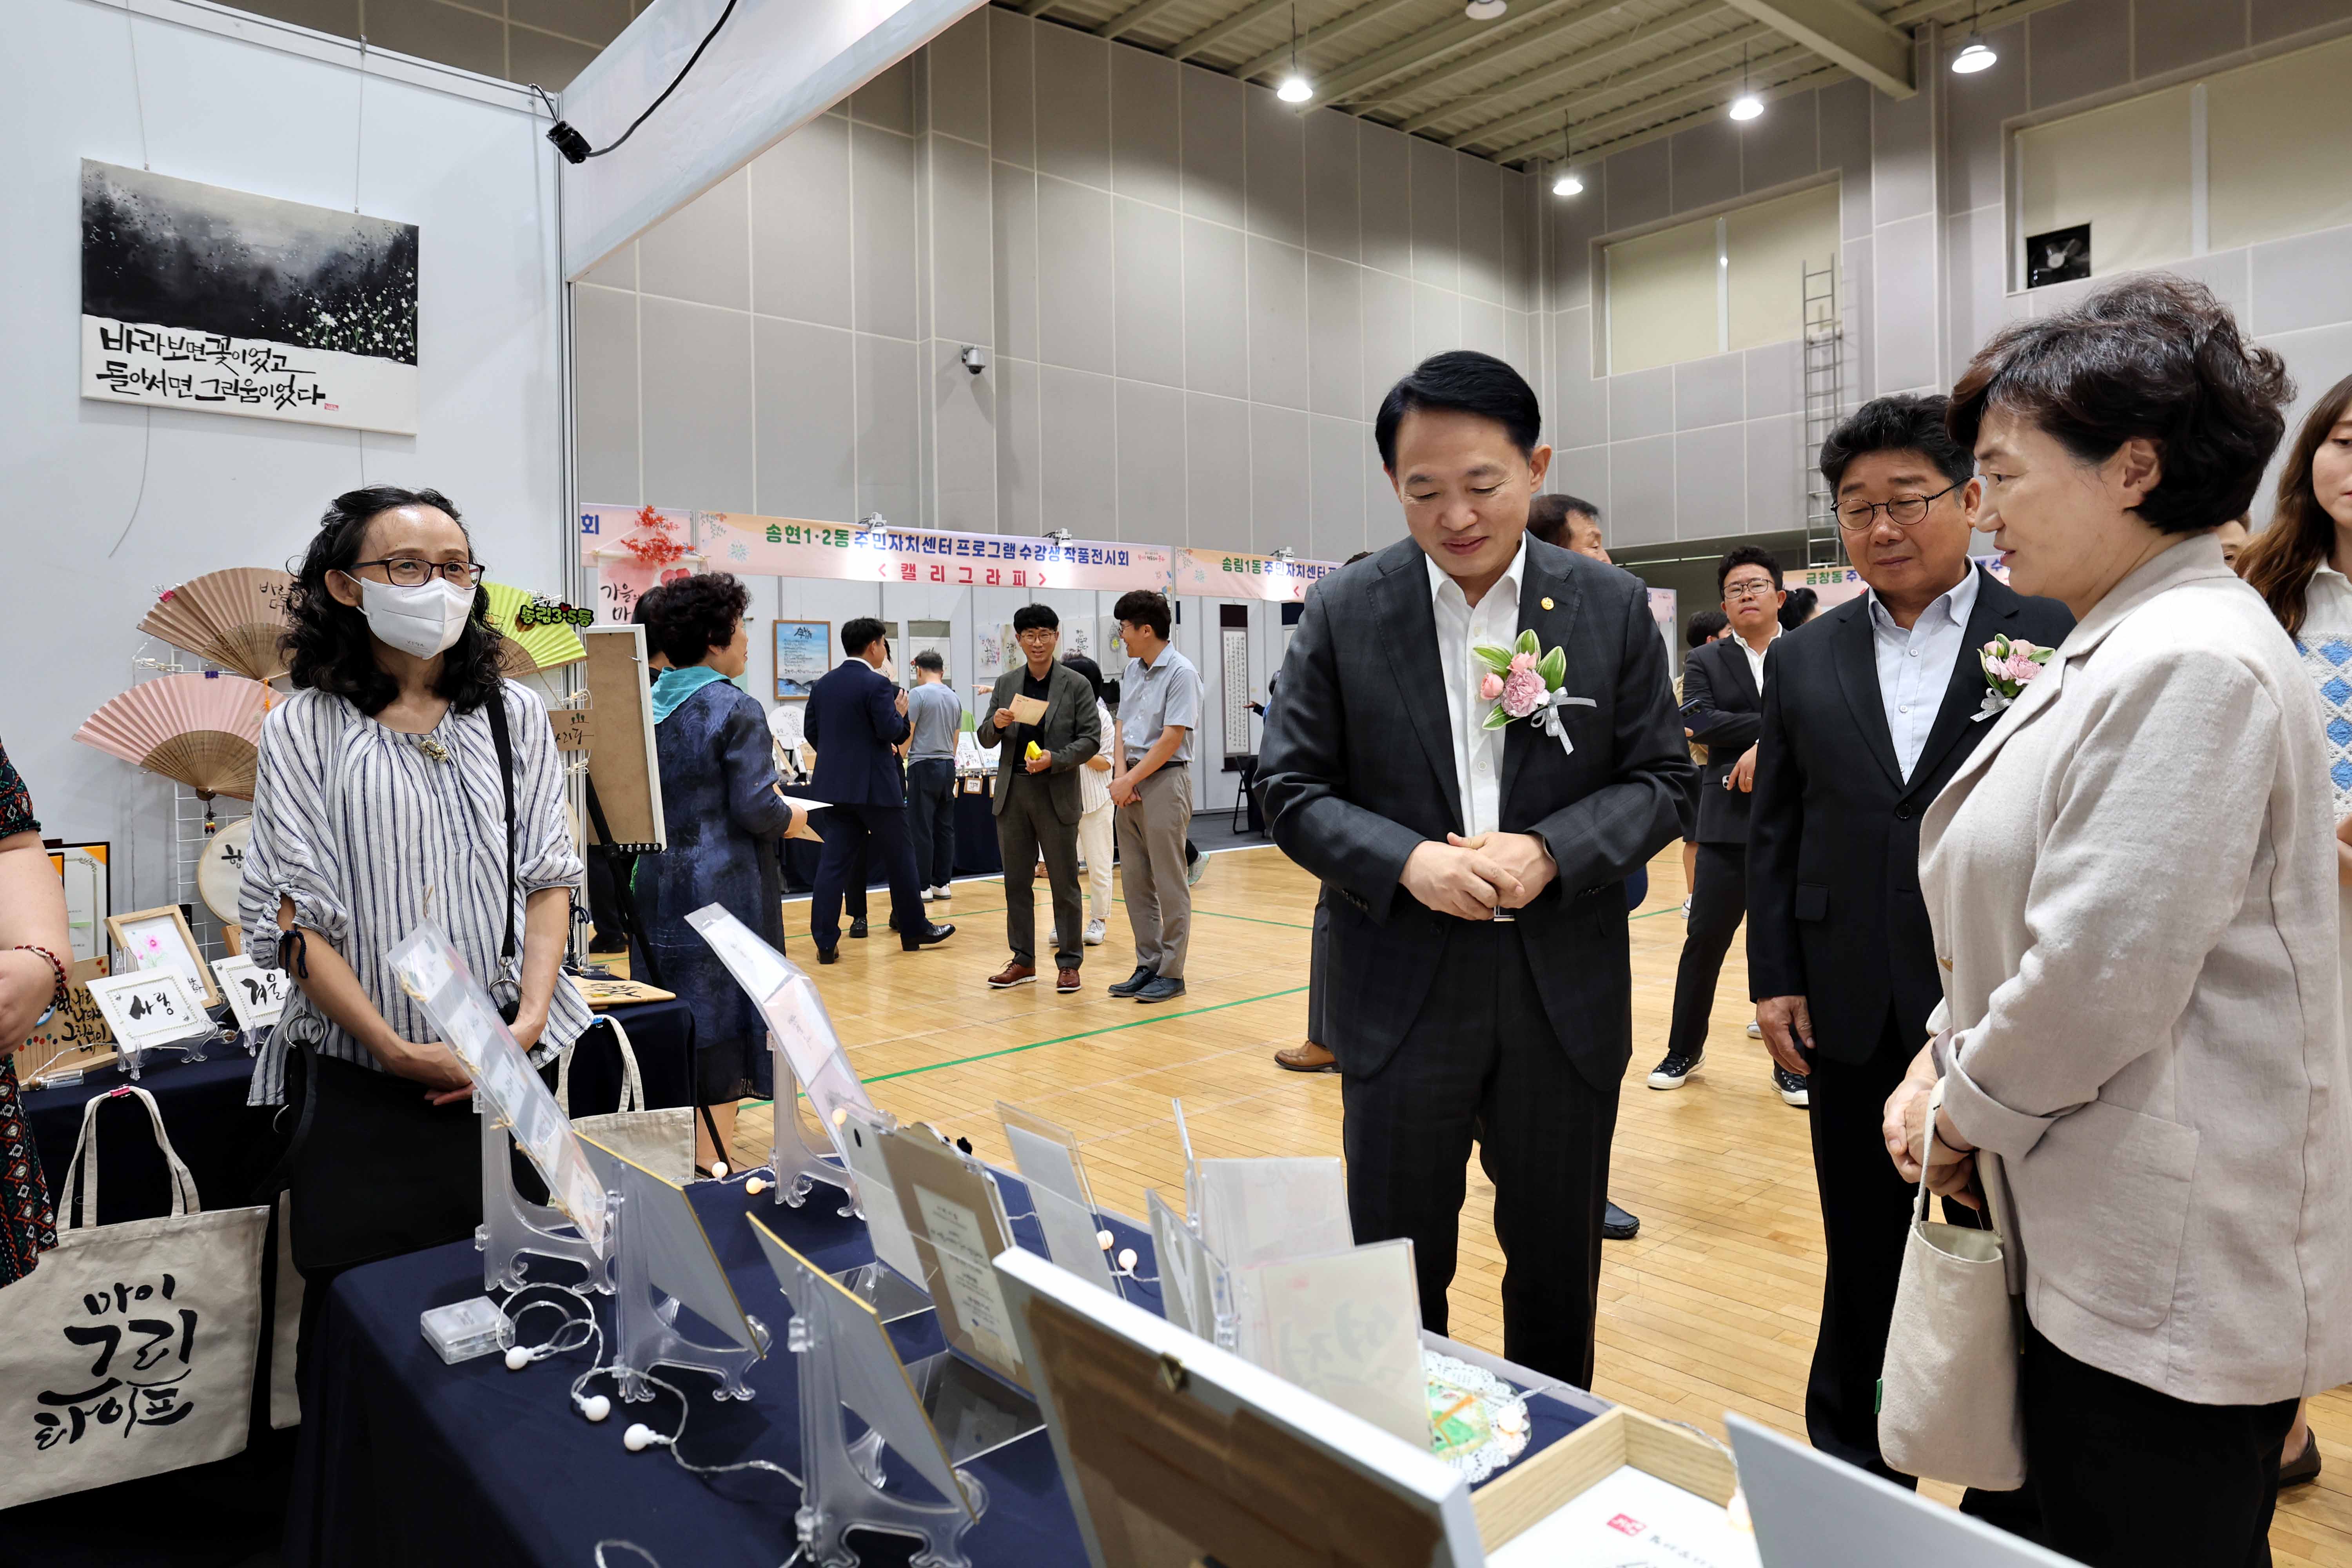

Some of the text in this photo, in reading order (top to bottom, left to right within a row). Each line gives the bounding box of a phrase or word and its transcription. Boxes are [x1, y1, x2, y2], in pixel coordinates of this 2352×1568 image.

[96, 360, 326, 410] 돌아서면 그리움이었다
[581, 513, 599, 535] 회
[766, 523, 849, 548] 송현1·2동
[855, 531, 953, 555] 주민자치센터
[956, 539, 1016, 560] 프로그램
[1019, 544, 1060, 562] 수강생
[1063, 546, 1129, 566] 작품전시회
[1222, 557, 1261, 575] 송림1동
[1806, 570, 1843, 585] 금창동
[129, 992, 174, 1020] 사랑
[83, 1274, 175, 1315] 마이
[34, 1388, 194, 1451] 라이프
